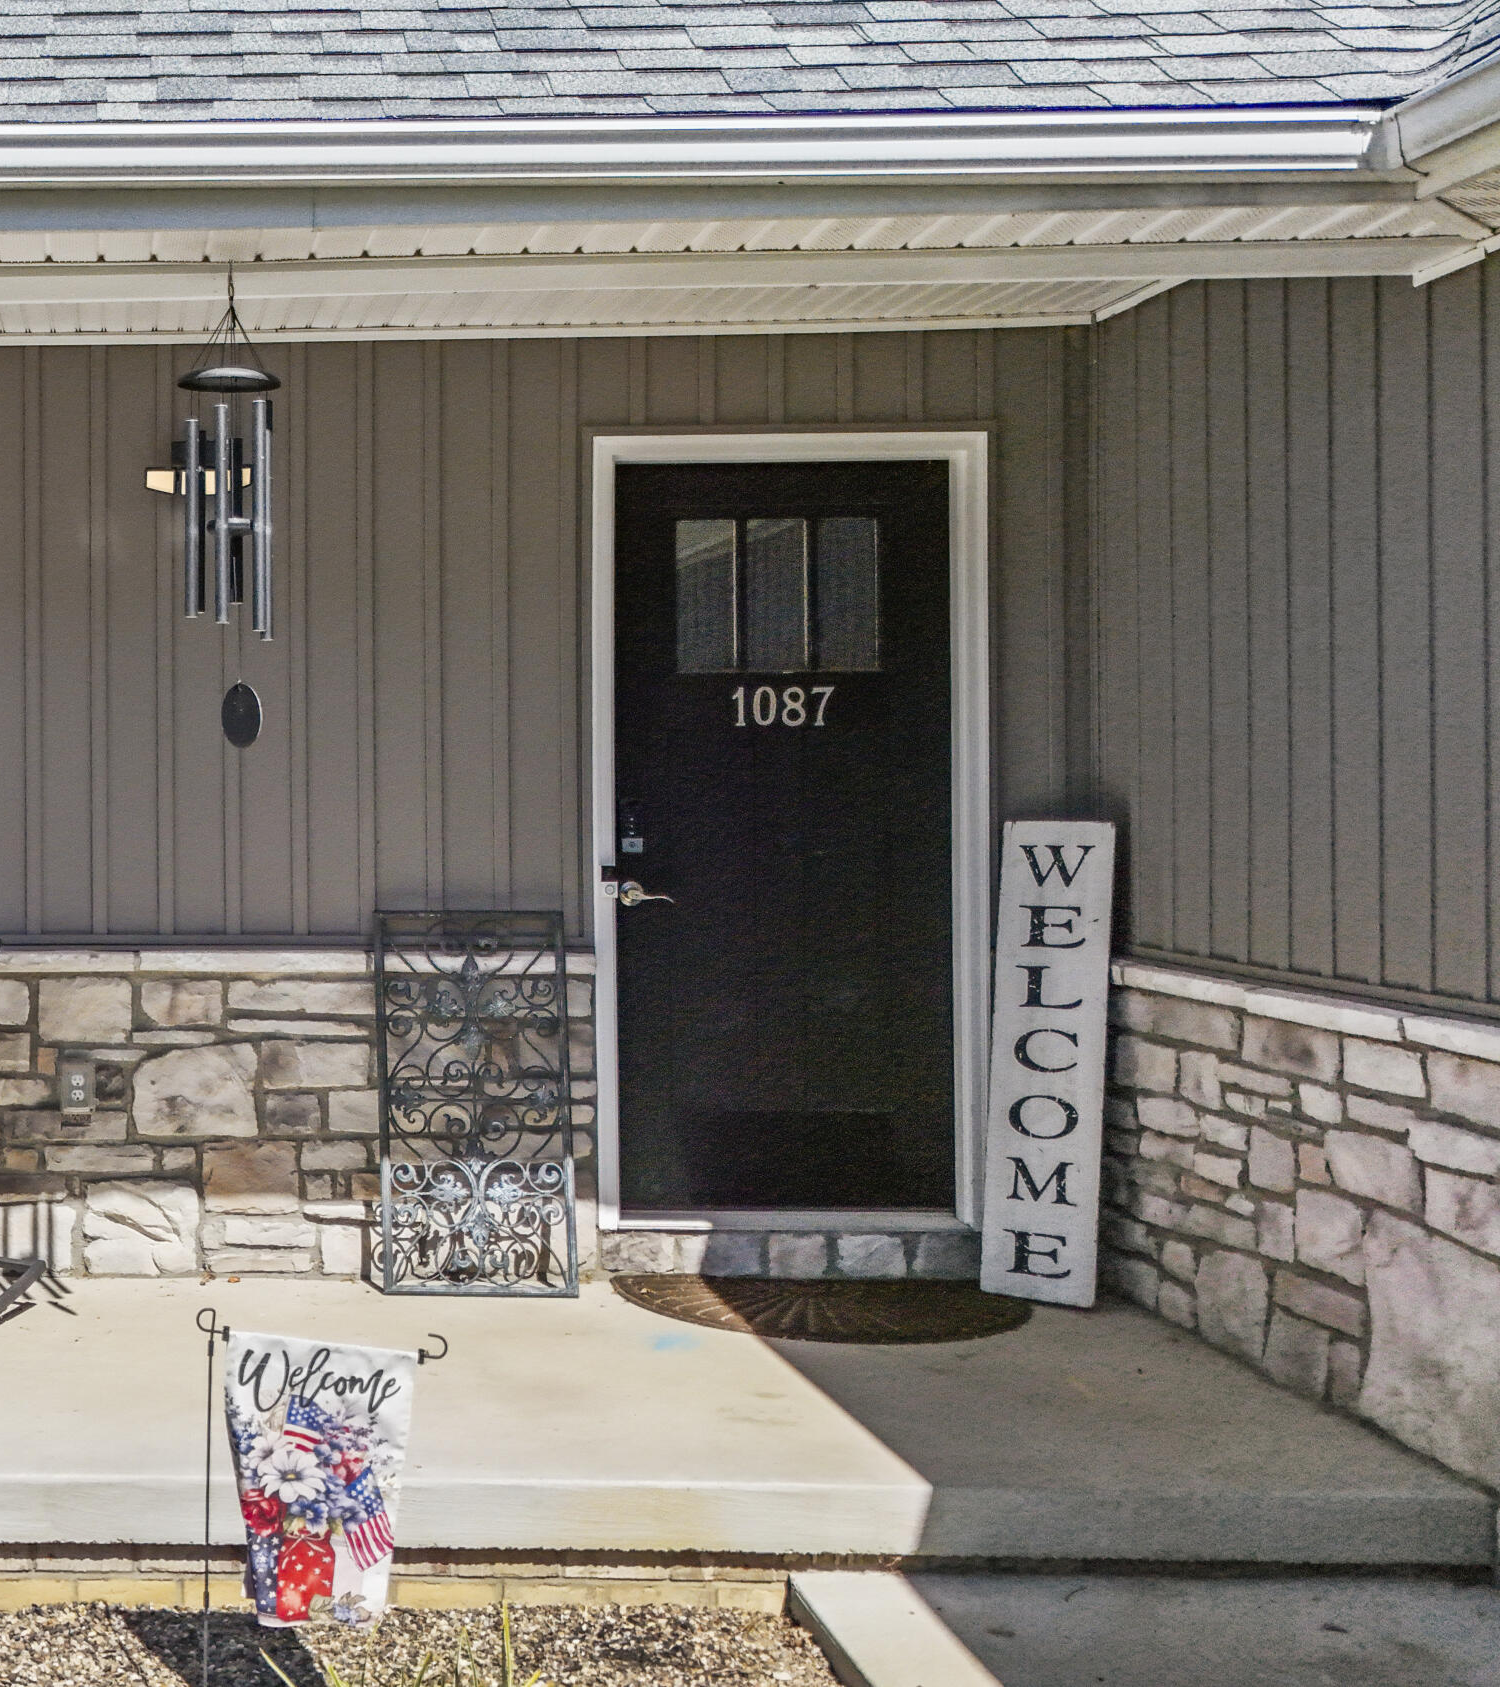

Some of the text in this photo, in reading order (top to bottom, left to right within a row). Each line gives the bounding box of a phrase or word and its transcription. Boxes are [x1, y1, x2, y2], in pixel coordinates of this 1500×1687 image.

[731, 686, 835, 727] 1087
[1002, 844, 1095, 1280] WELCOME
[238, 1347, 402, 1414] Welcome
